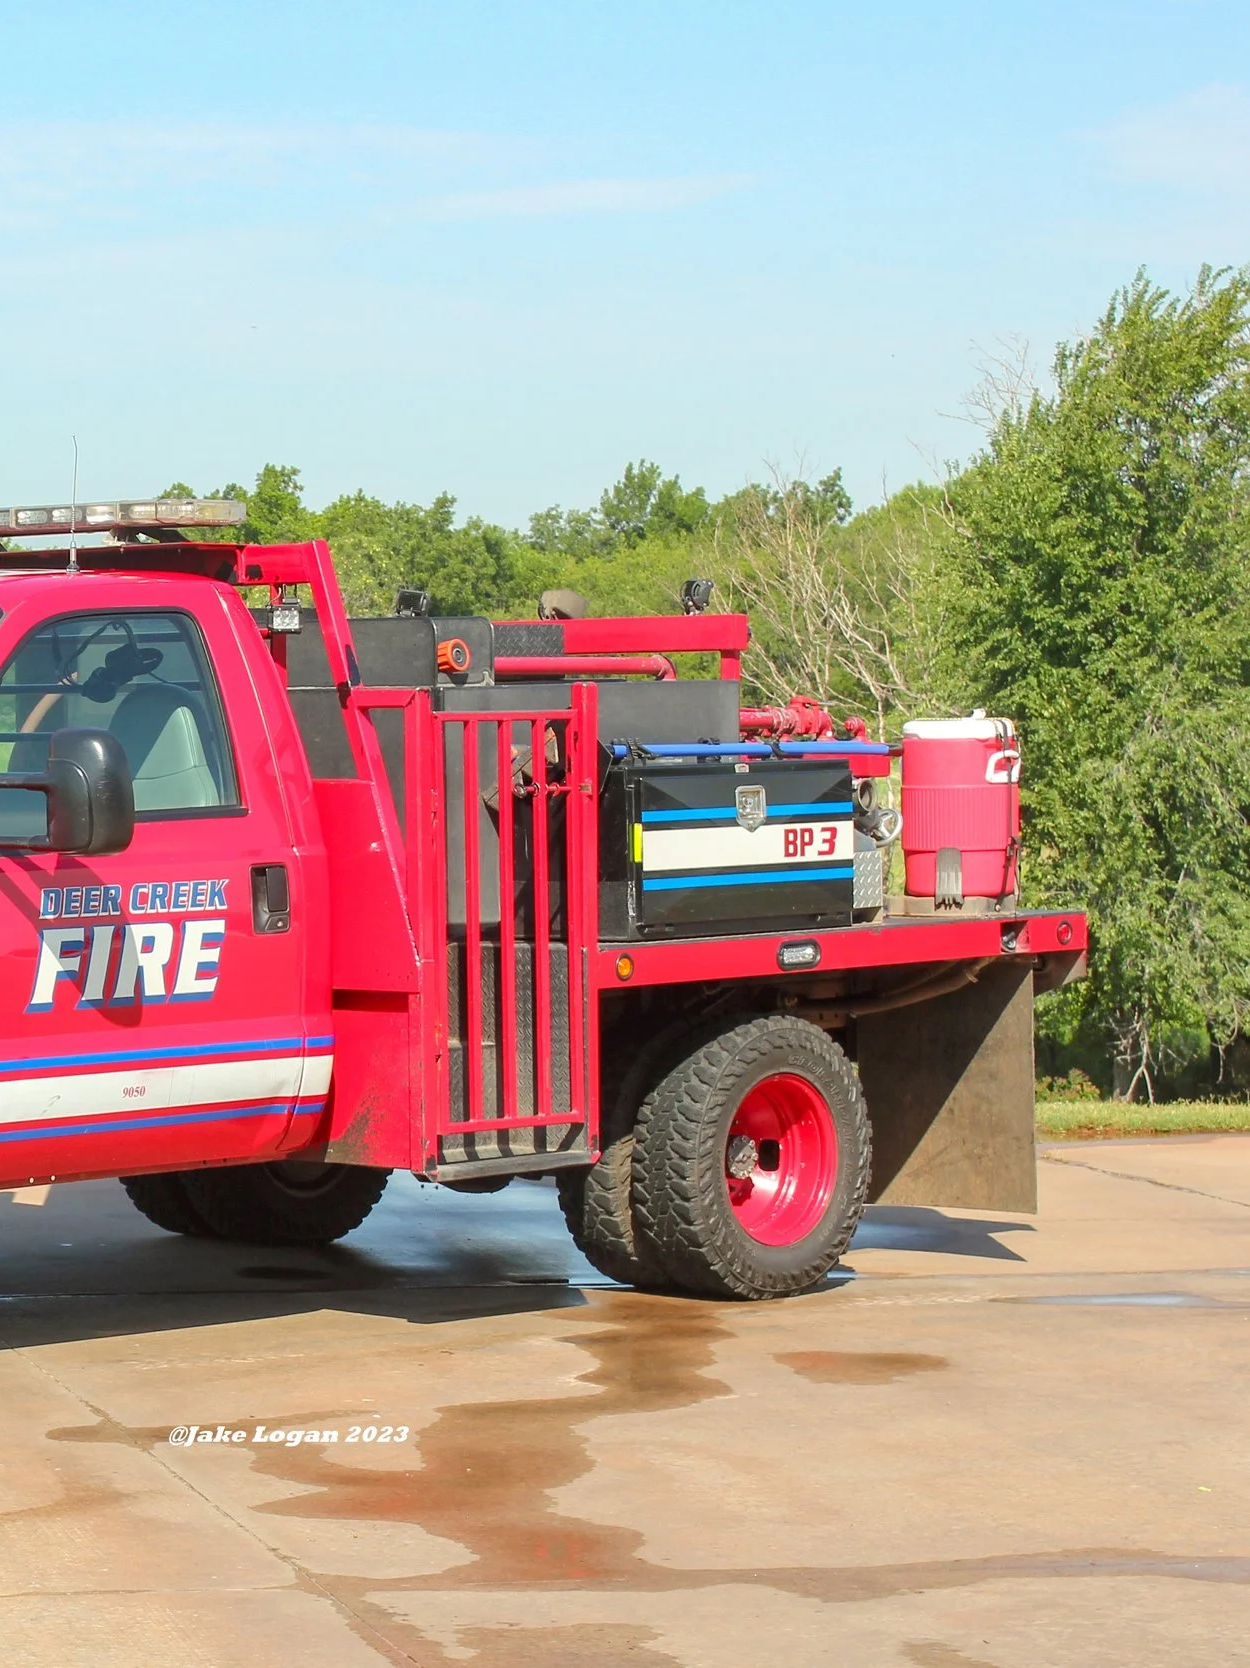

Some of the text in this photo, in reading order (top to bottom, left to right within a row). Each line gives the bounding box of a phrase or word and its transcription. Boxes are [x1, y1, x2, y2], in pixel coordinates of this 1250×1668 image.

[784, 827, 838, 857] BP 3
[39, 879, 230, 919] DEER CREEK
[23, 918, 226, 1014] FIRE
[122, 1085, 146, 1099] 9050
